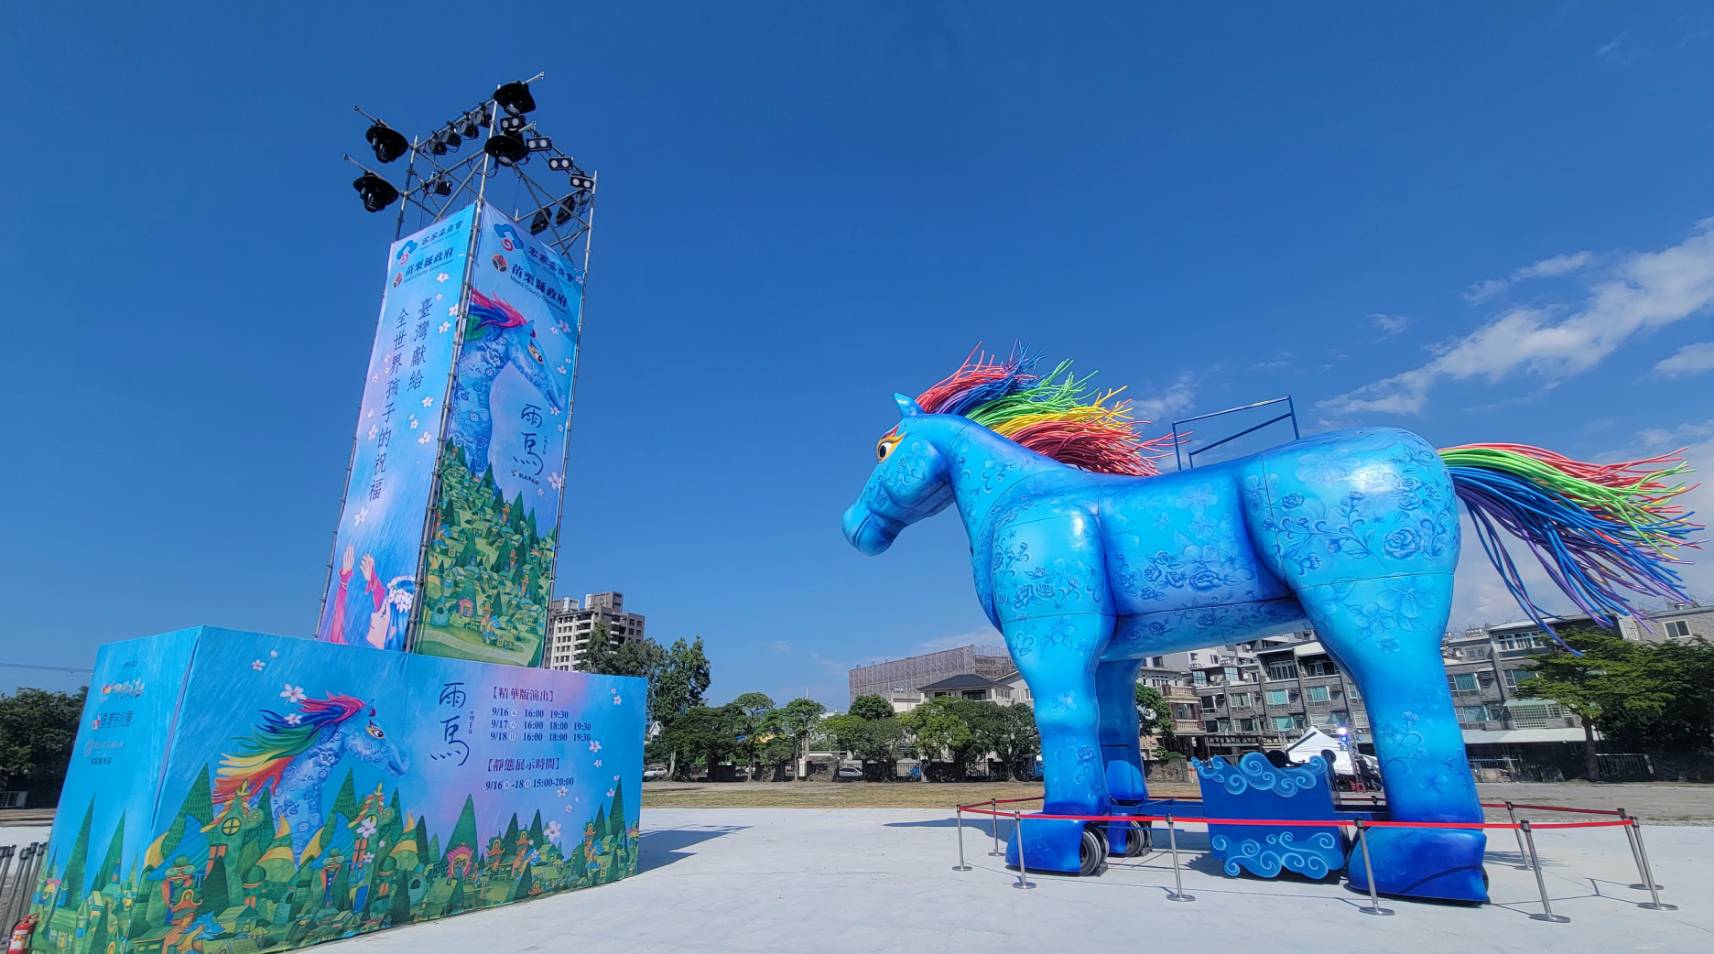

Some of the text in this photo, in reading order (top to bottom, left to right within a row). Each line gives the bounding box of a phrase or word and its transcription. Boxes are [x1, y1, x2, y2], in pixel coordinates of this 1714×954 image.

[406, 247, 454, 277] 苗栗縣政府
[512, 264, 567, 307] 苗栗縣政府
[407, 297, 433, 392] 臺灣獻給
[369, 308, 410, 501] 全世界孩子的祝福
[513, 404, 543, 475] 雨馬
[431, 683, 469, 766] 雨馬
[491, 720, 508, 729] 9/17
[523, 721, 544, 730] 16:00
[549, 721, 568, 730] 18:00
[574, 722, 592, 731] 19:30
[492, 708, 509, 717] 9/16
[524, 709, 544, 718] 16:00
[550, 710, 569, 719] 19:30
[490, 731, 508, 741] 9/18
[523, 732, 543, 741] 16:00
[549, 732, 568, 741] 18:00
[573, 733, 591, 742] 19:30
[485, 780, 503, 790] 9/16
[533, 777, 574, 788] 15:00-20:00
